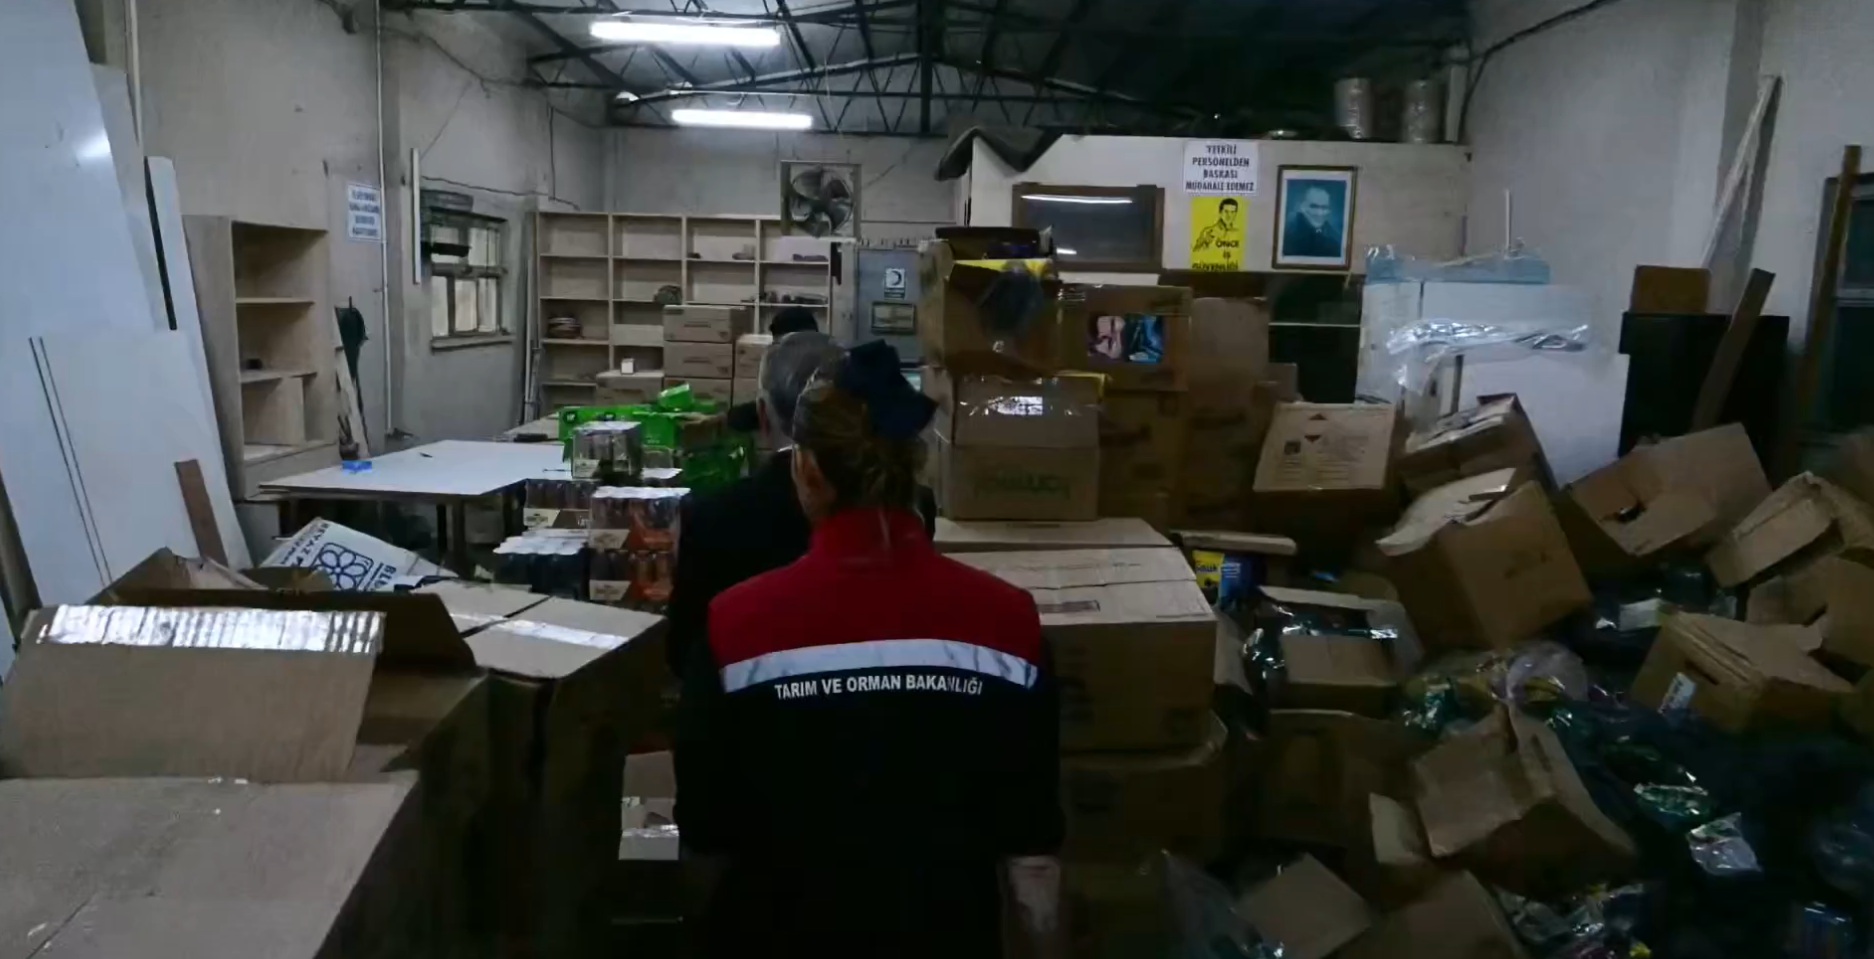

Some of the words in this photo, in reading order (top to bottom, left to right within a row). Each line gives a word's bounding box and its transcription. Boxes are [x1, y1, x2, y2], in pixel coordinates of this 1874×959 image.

[774, 680, 818, 700] TARIM
[822, 678, 842, 695] VE
[846, 674, 901, 693] ORMAN
[905, 674, 983, 696] BAKANLIĞI
